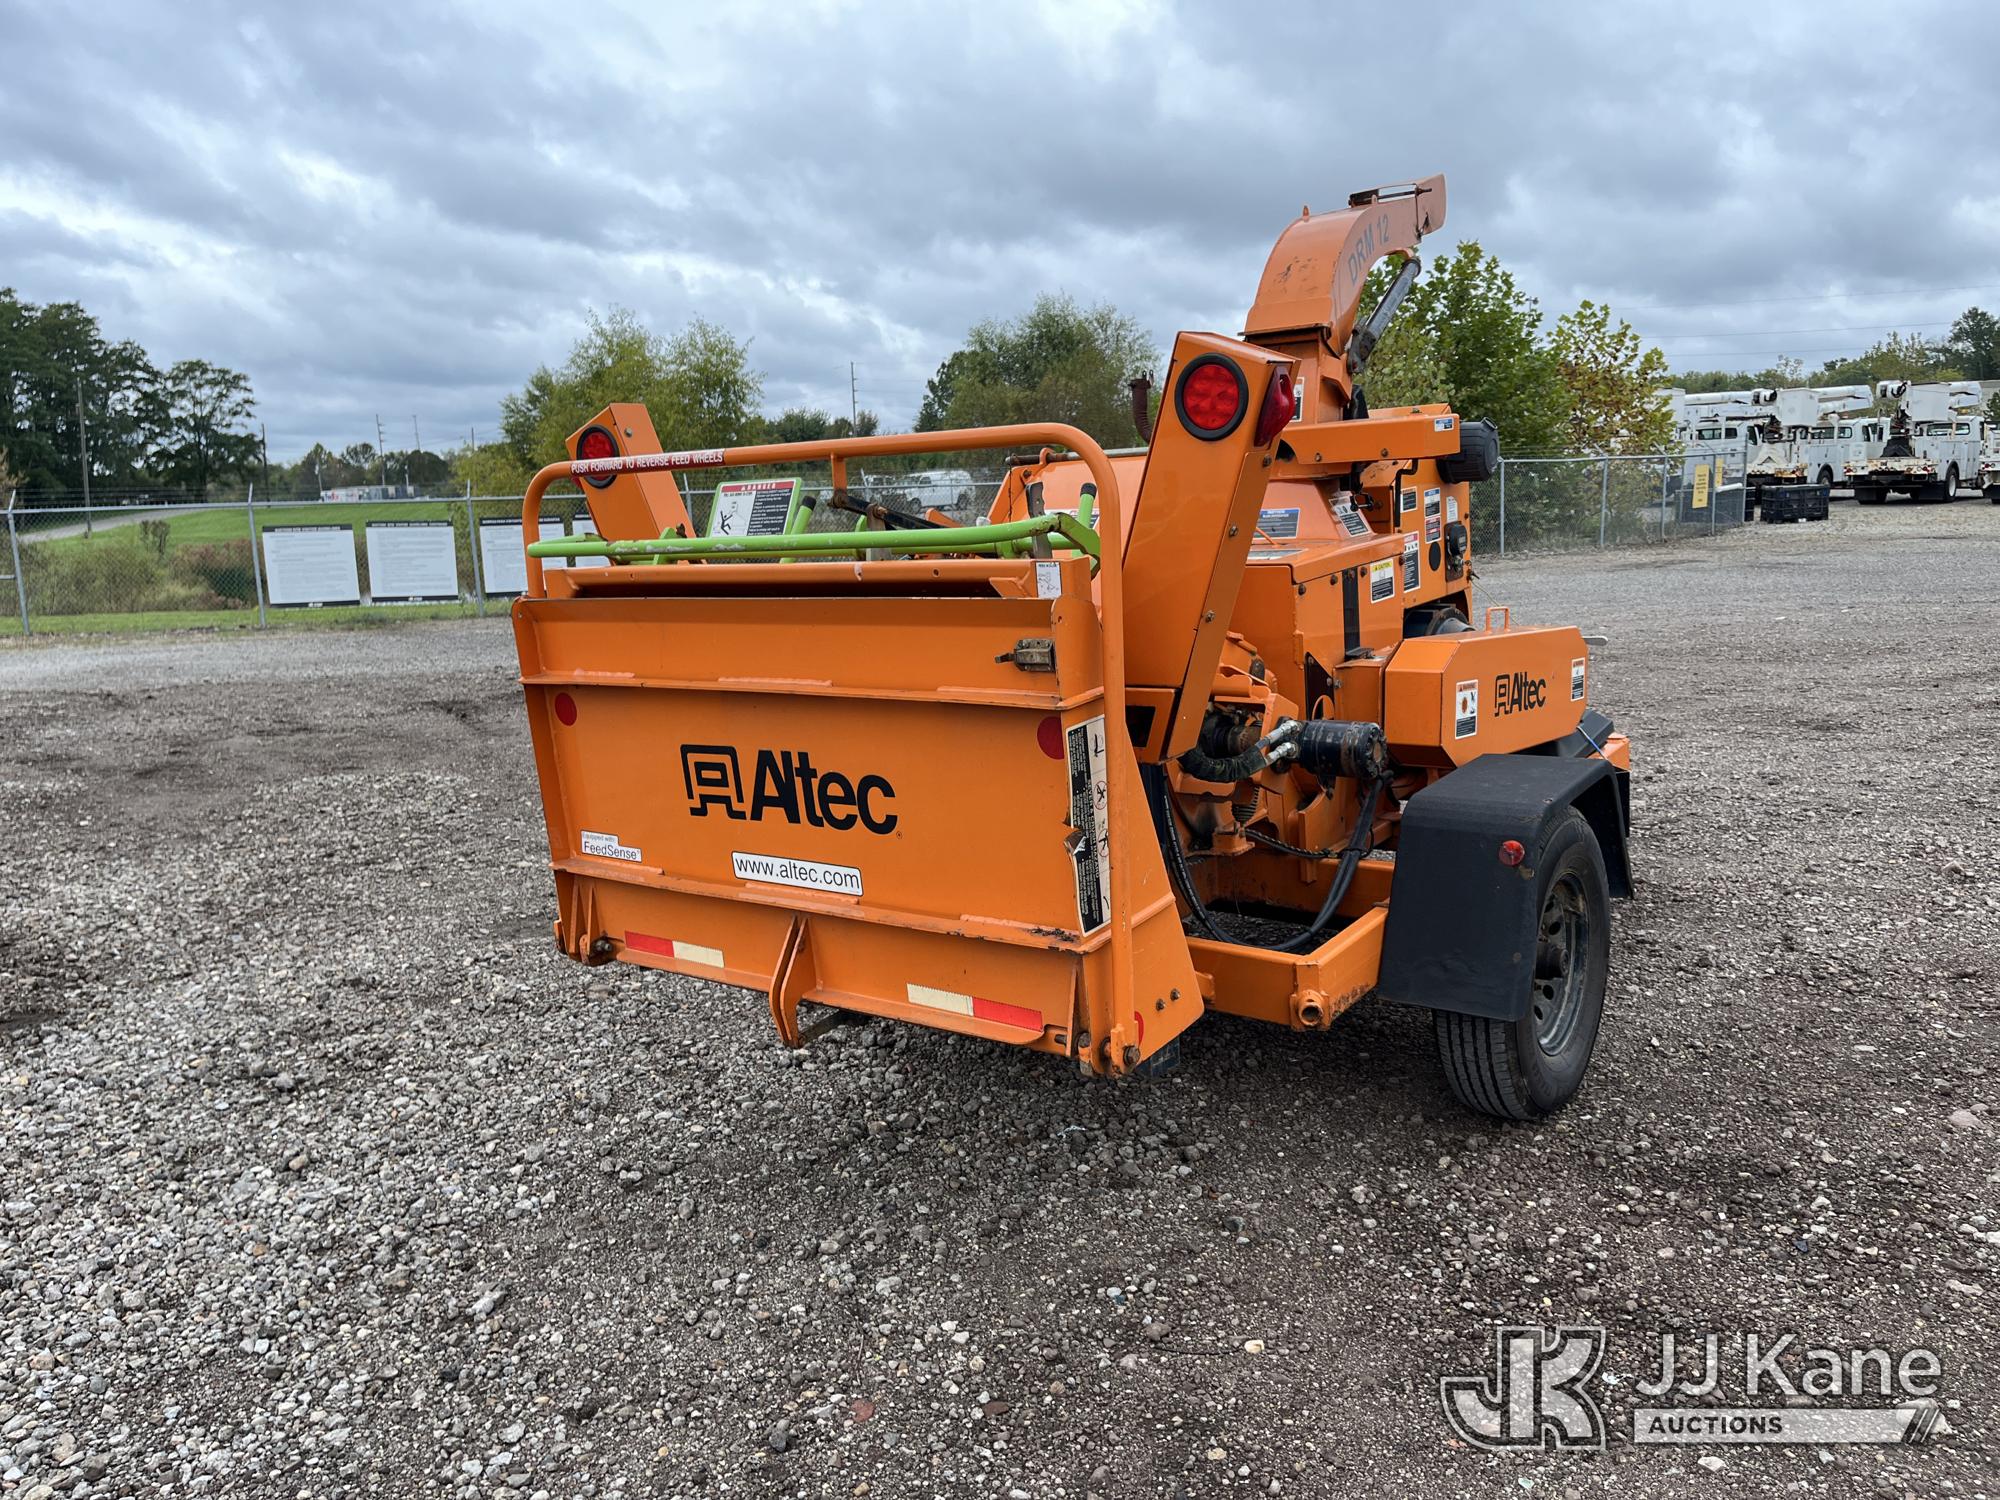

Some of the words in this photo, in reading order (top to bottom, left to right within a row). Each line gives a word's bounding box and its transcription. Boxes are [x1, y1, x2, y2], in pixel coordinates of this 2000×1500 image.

[1348, 223, 1375, 286] DRM
[1377, 213, 1389, 244] 12
[571, 462, 588, 474] PUSH
[590, 459, 623, 472] FORWARD
[625, 459, 634, 469] TO
[636, 455, 669, 468] REVERSE
[671, 454, 690, 466] FEED
[692, 451, 723, 464] WHEELS
[1510, 671, 1546, 714] Altec
[750, 749, 898, 835] Altec
[584, 841, 637, 860] FeedSense
[734, 856, 861, 889] www.altec.com
